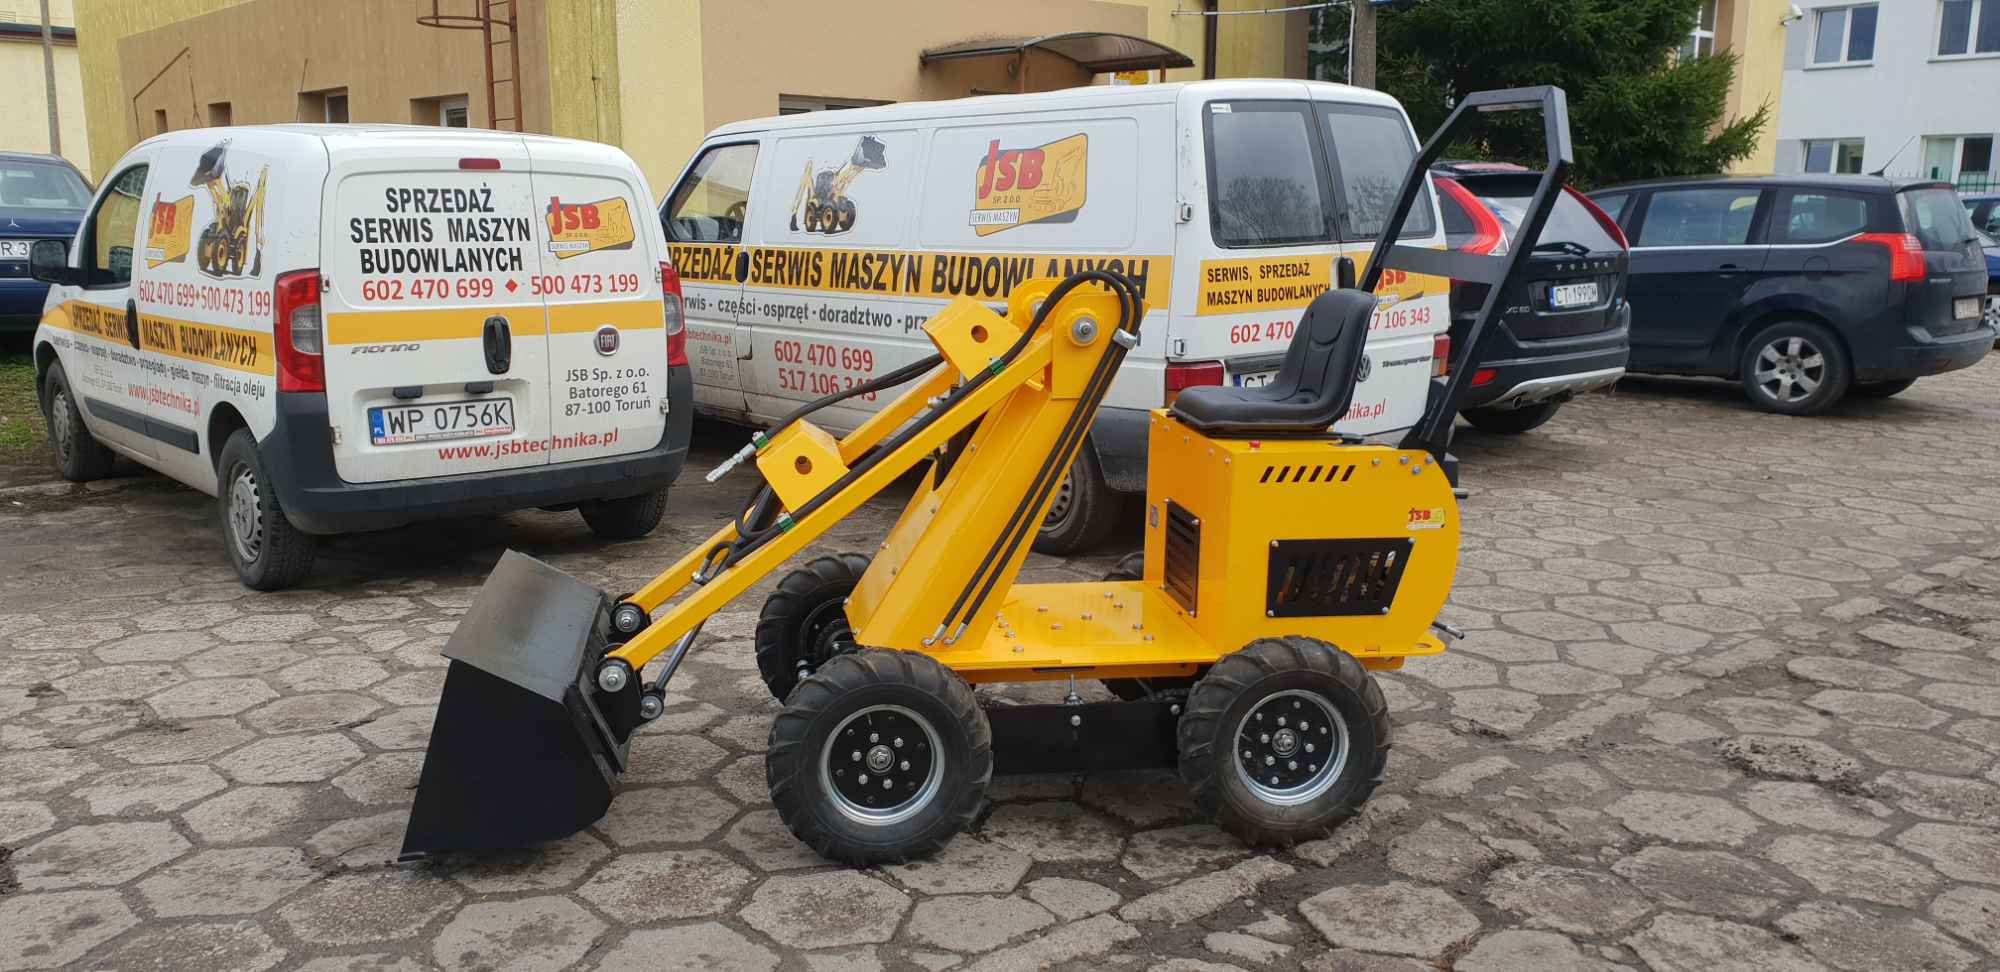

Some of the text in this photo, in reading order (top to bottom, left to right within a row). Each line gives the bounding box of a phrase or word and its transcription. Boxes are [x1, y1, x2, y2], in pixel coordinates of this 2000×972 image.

[979, 139, 1045, 199] JSB
[386, 182, 494, 213] SPRZEDAŻ
[550, 196, 601, 235] JSB
[350, 218, 531, 243] SERWIS MASZYN
[360, 248, 523, 274] BUDOWLANYCH
[751, 249, 823, 287] SERWIS
[830, 252, 922, 292] MASZYN
[1207, 260, 1310, 282] SERWIS, SPRZEDAŻ
[139, 280, 271, 317] 602 470 699 500 473 199
[362, 274, 639, 301] 602 470 699 500 473 199
[1207, 290, 1253, 306] MASZYN
[718, 297, 756, 318] części
[763, 304, 808, 324] osprzęt
[819, 303, 892, 327] doradztwo
[1385, 310, 1406, 329] 106
[1410, 307, 1431, 326] 343
[141, 318, 176, 351] MASZYN
[180, 325, 256, 367] BUDOWLANYCH
[1230, 320, 1294, 344] 602 470
[774, 340, 873, 372] 602 470 699
[566, 368, 650, 382] JSB Sp. z o.o.
[779, 368, 806, 391] 517
[810, 372, 839, 395] 106
[244, 378, 265, 400] oleju
[569, 381, 648, 399] Batorego 61
[388, 409, 424, 435] WP
[434, 402, 509, 430] 0756K
[565, 395, 651, 416] 87-100 Toruń
[438, 427, 619, 460] www.jsbtechnika.pl
